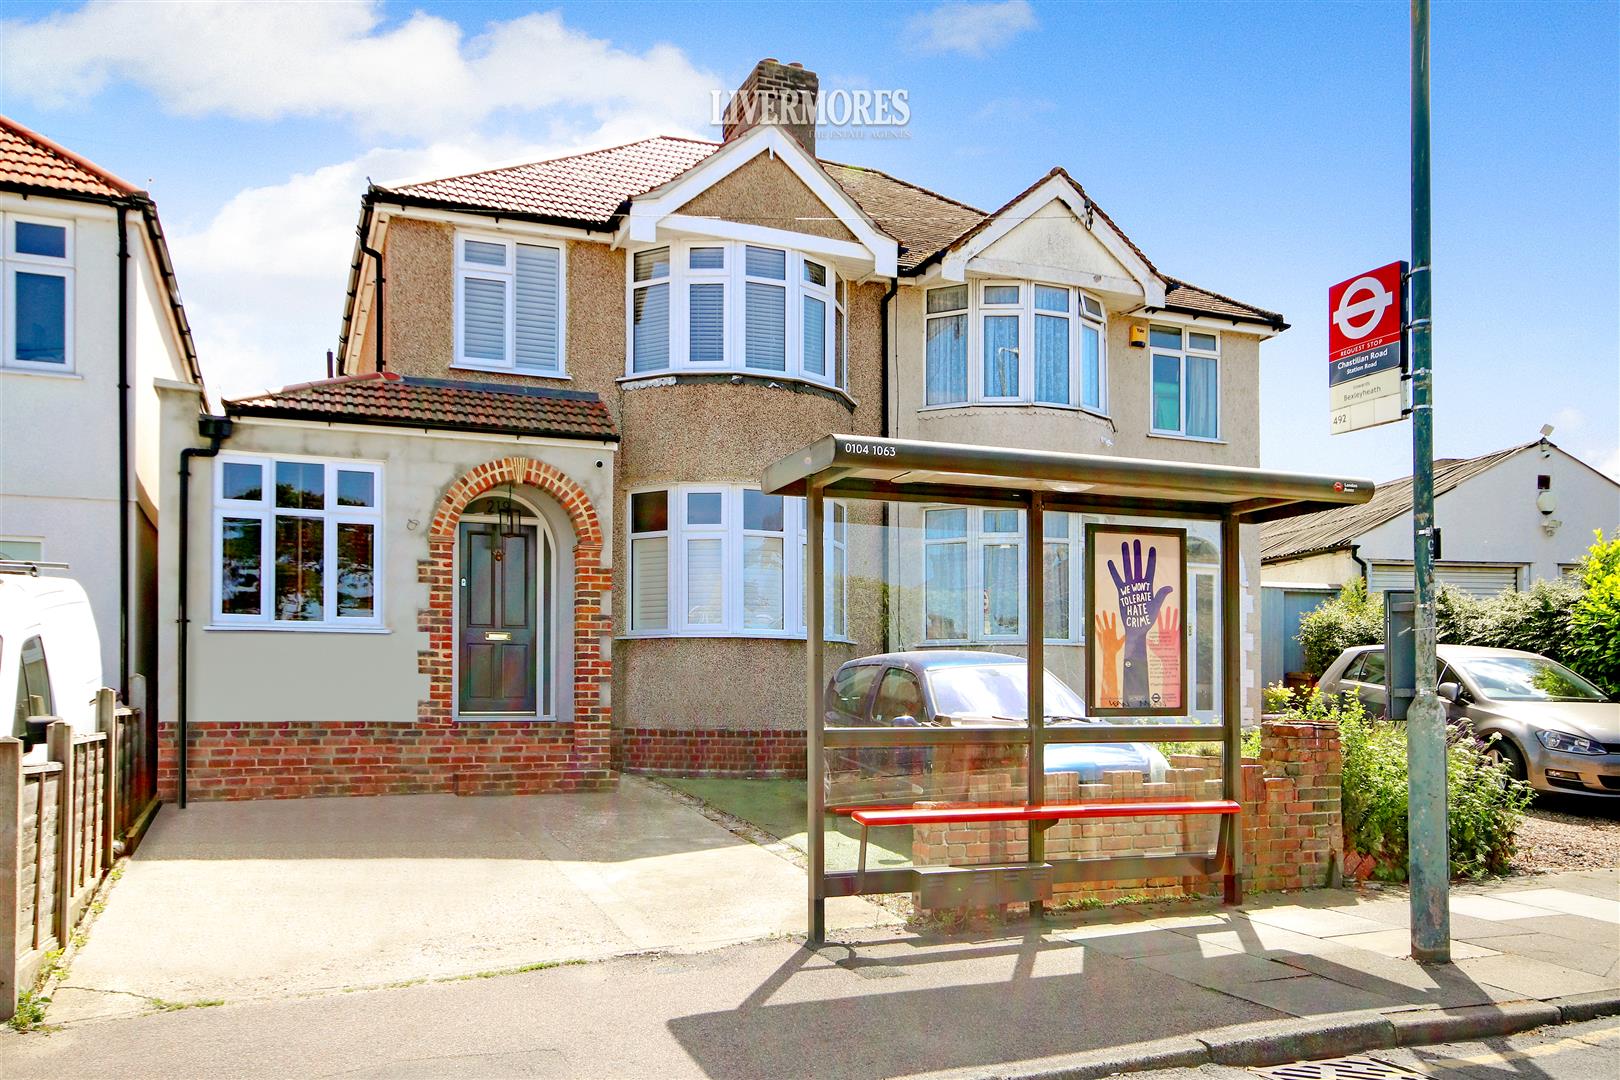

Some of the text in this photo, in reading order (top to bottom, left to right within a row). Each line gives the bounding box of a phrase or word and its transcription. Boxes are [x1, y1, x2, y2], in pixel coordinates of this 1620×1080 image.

[1340, 338, 1383, 357] REQUEST STOP
[1370, 348, 1388, 360] Road
[1346, 360, 1378, 375] Station Road
[1343, 386, 1381, 402] Bexleyheath
[1333, 414, 1347, 425] 492
[845, 443, 896, 457] 0104 1063
[1120, 582, 1151, 596] WE WON'T
[1120, 592, 1152, 607] TOLERATE
[1127, 603, 1148, 616] HATE
[1126, 615, 1151, 628] CRIME
